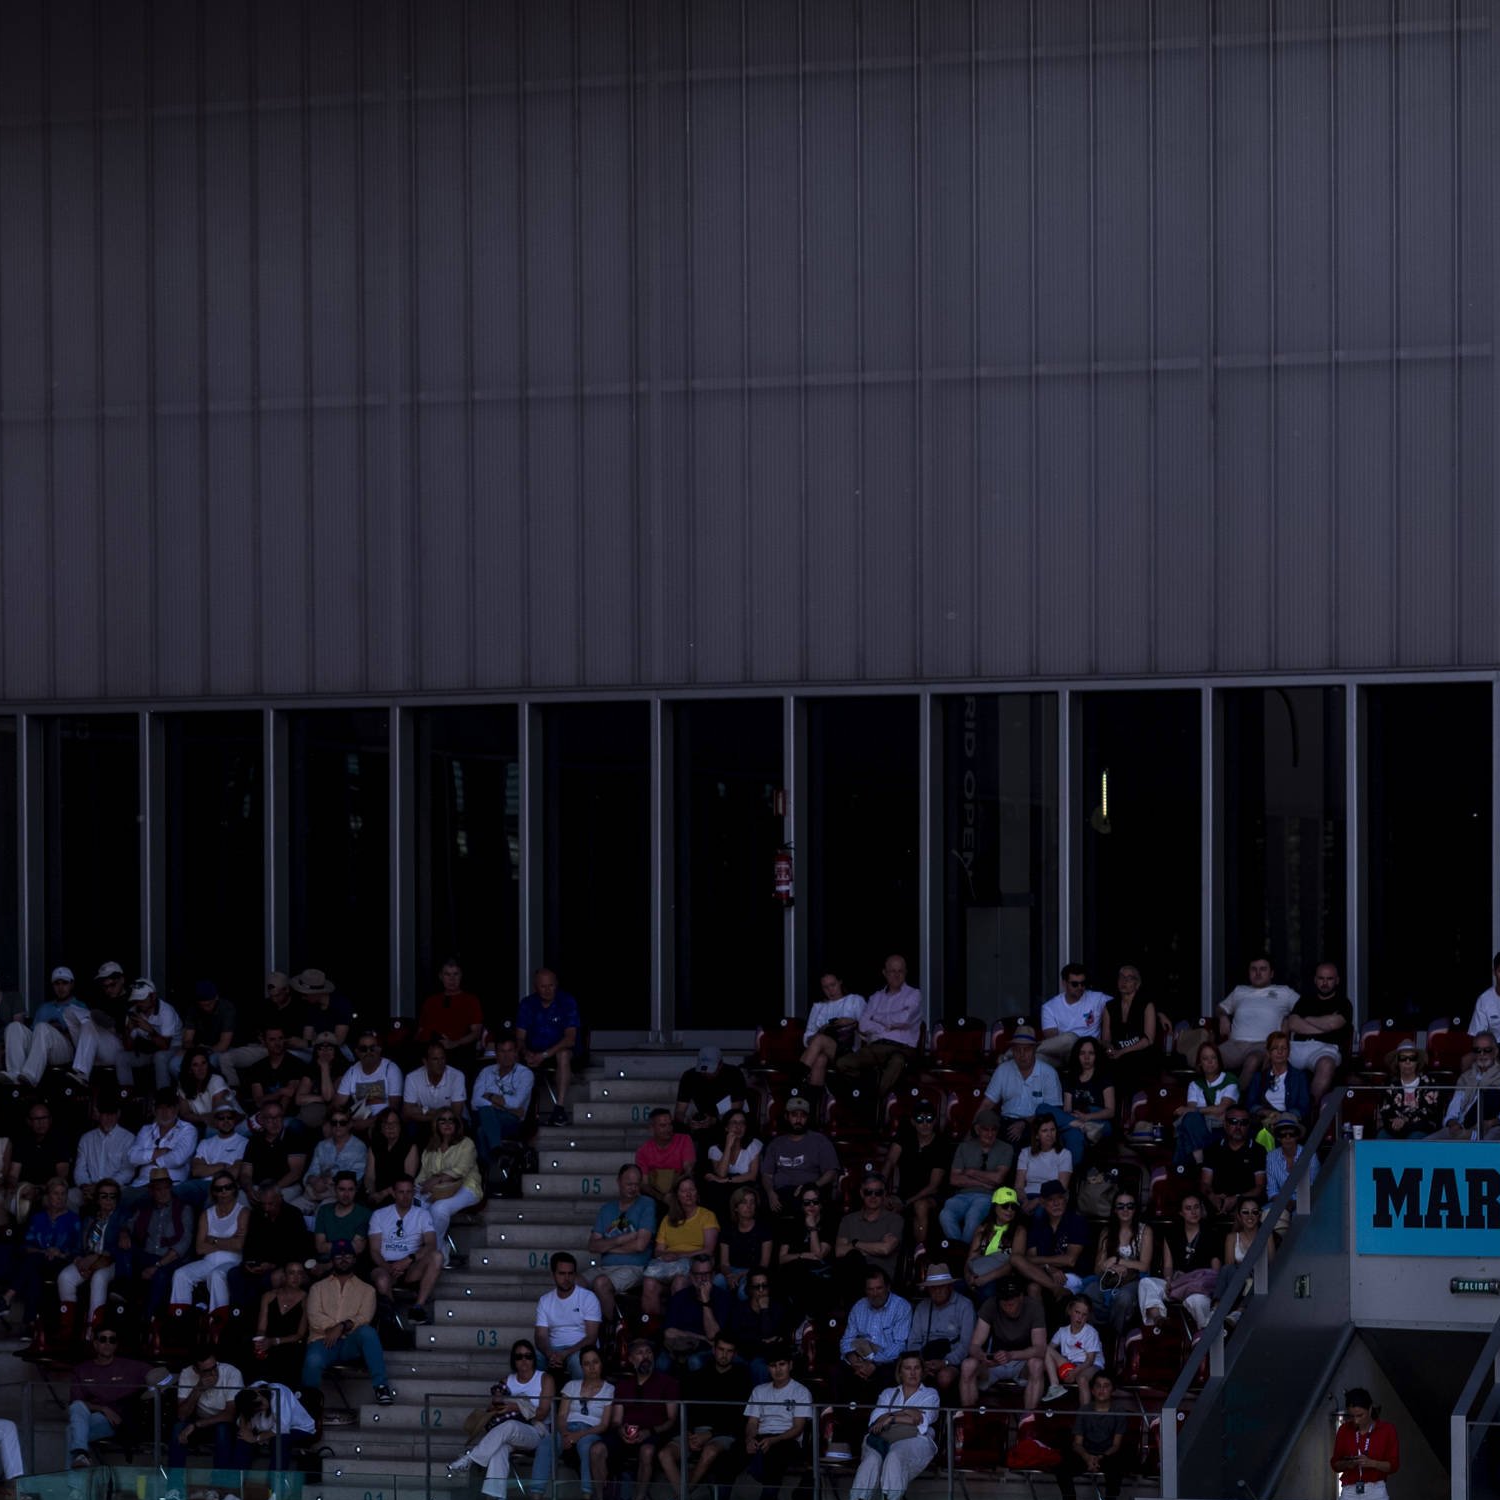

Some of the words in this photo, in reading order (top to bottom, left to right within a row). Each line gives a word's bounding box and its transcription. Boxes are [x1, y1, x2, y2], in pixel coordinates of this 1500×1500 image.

[631, 1106, 651, 1122] 06
[581, 1177, 602, 1194] 05
[528, 1252, 549, 1269] 04
[1457, 1280, 1490, 1291] SALIDA
[476, 1330, 498, 1347] 03
